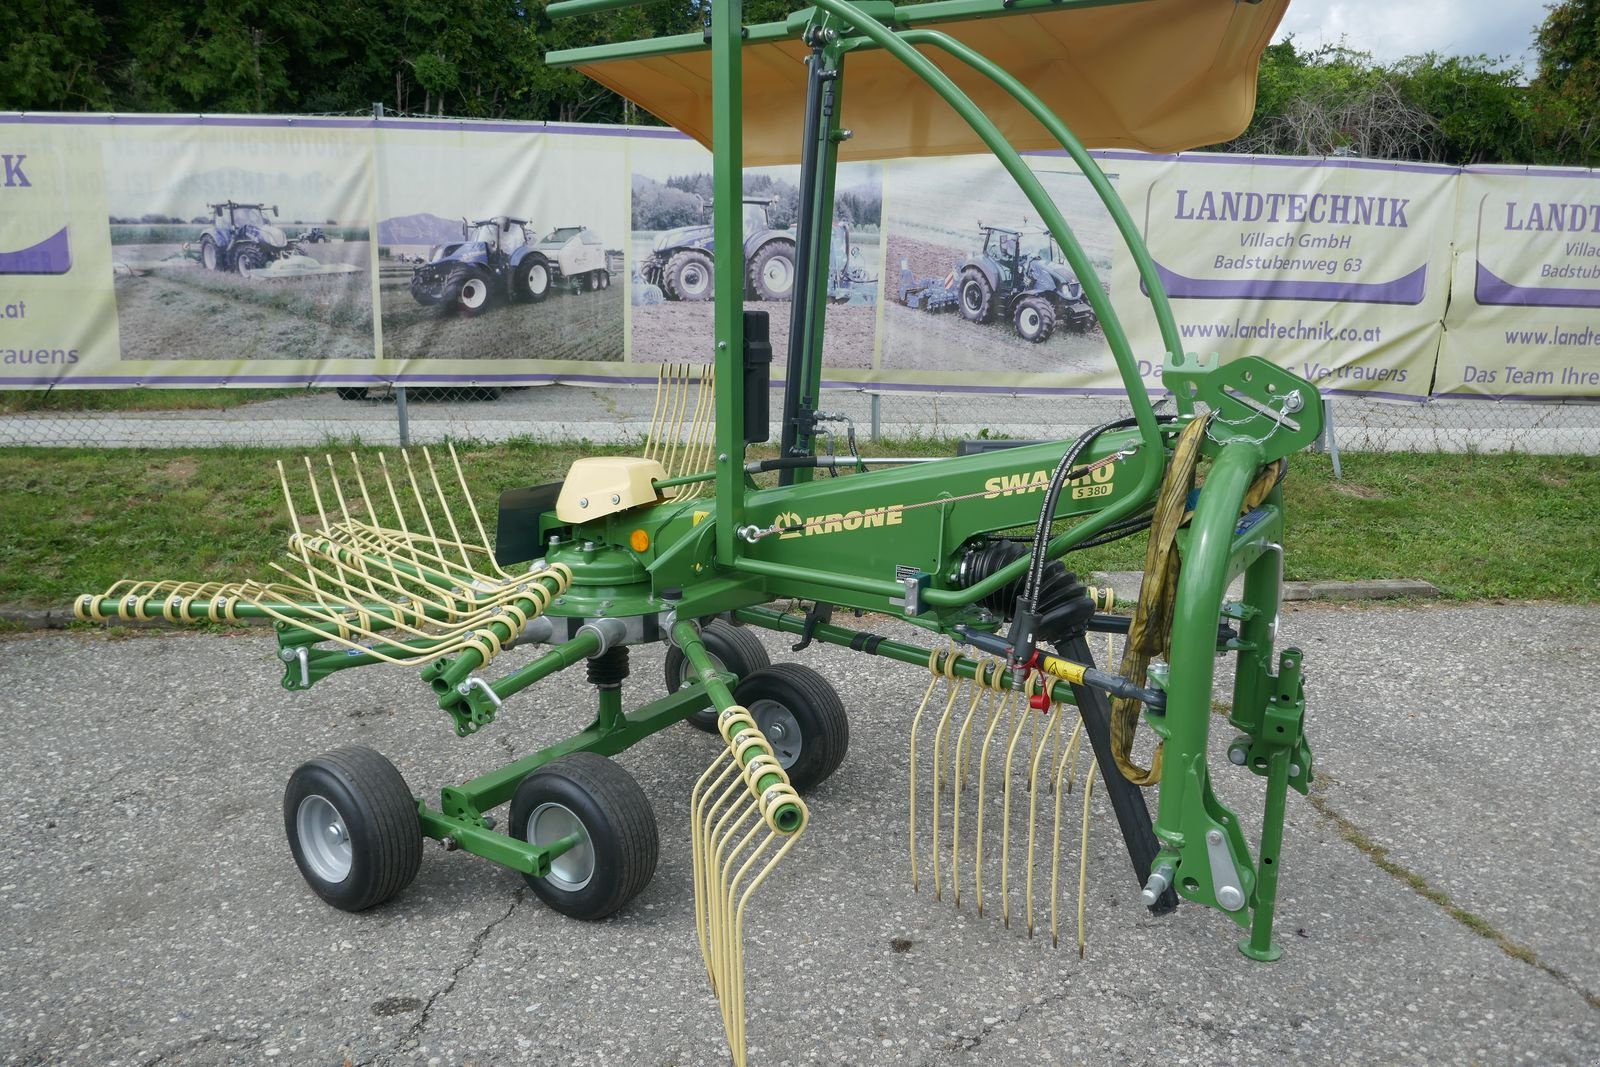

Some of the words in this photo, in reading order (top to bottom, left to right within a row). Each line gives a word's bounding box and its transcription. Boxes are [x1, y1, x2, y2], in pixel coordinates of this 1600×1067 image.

[0, 154, 32, 187] K
[1174, 190, 1410, 227] LANDTECHNIK
[1240, 232, 1295, 248] Villach
[1298, 233, 1352, 249] GmbH
[1213, 254, 1338, 274] Badstubenweg
[1343, 258, 1362, 272] 63
[1180, 318, 1381, 342] www.landtechnik.co.at
[1463, 365, 1498, 383] Das
[1504, 366, 1554, 384] Team
[1077, 487, 1084, 498] S
[1087, 485, 1108, 495] 380
[805, 504, 904, 536] KRONE
